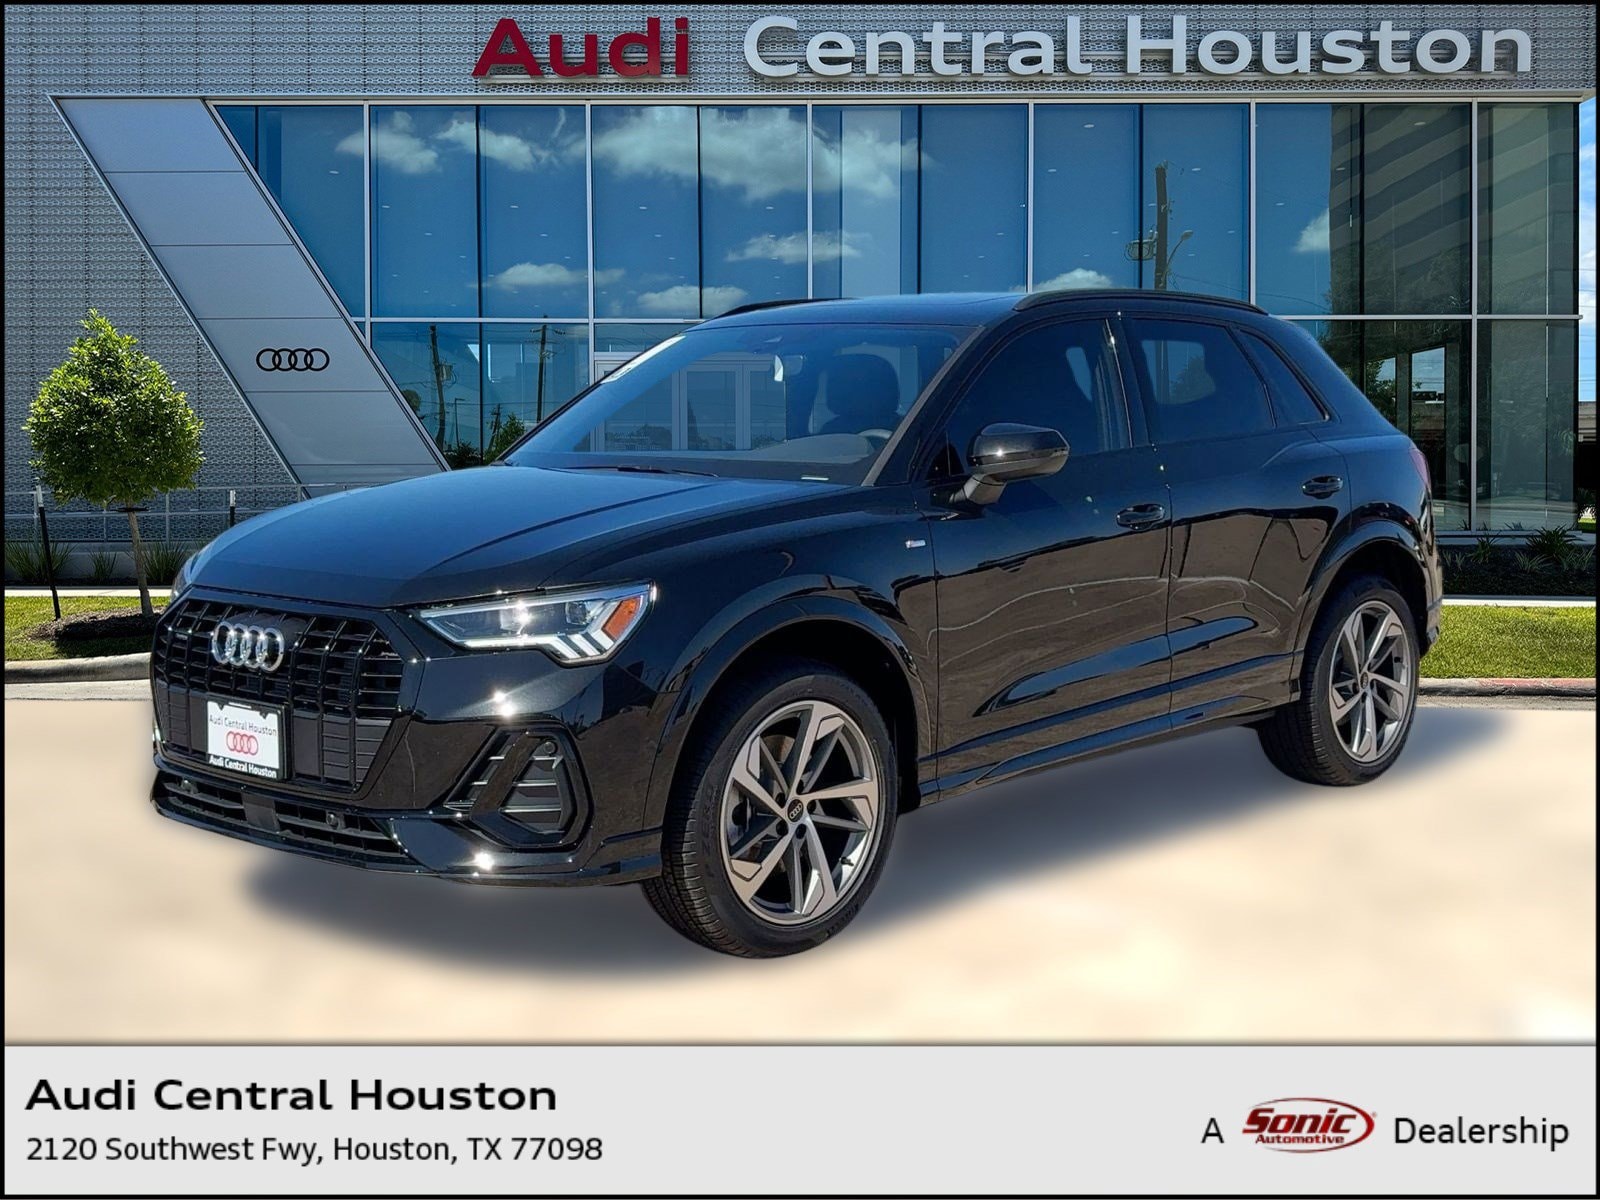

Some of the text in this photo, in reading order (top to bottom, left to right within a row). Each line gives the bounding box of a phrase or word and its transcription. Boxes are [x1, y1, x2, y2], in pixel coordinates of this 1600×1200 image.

[472, 15, 1533, 78] Audi Central Houston
[209, 714, 277, 737] Audi Central Houston
[209, 755, 277, 779] Audi Central Houston
